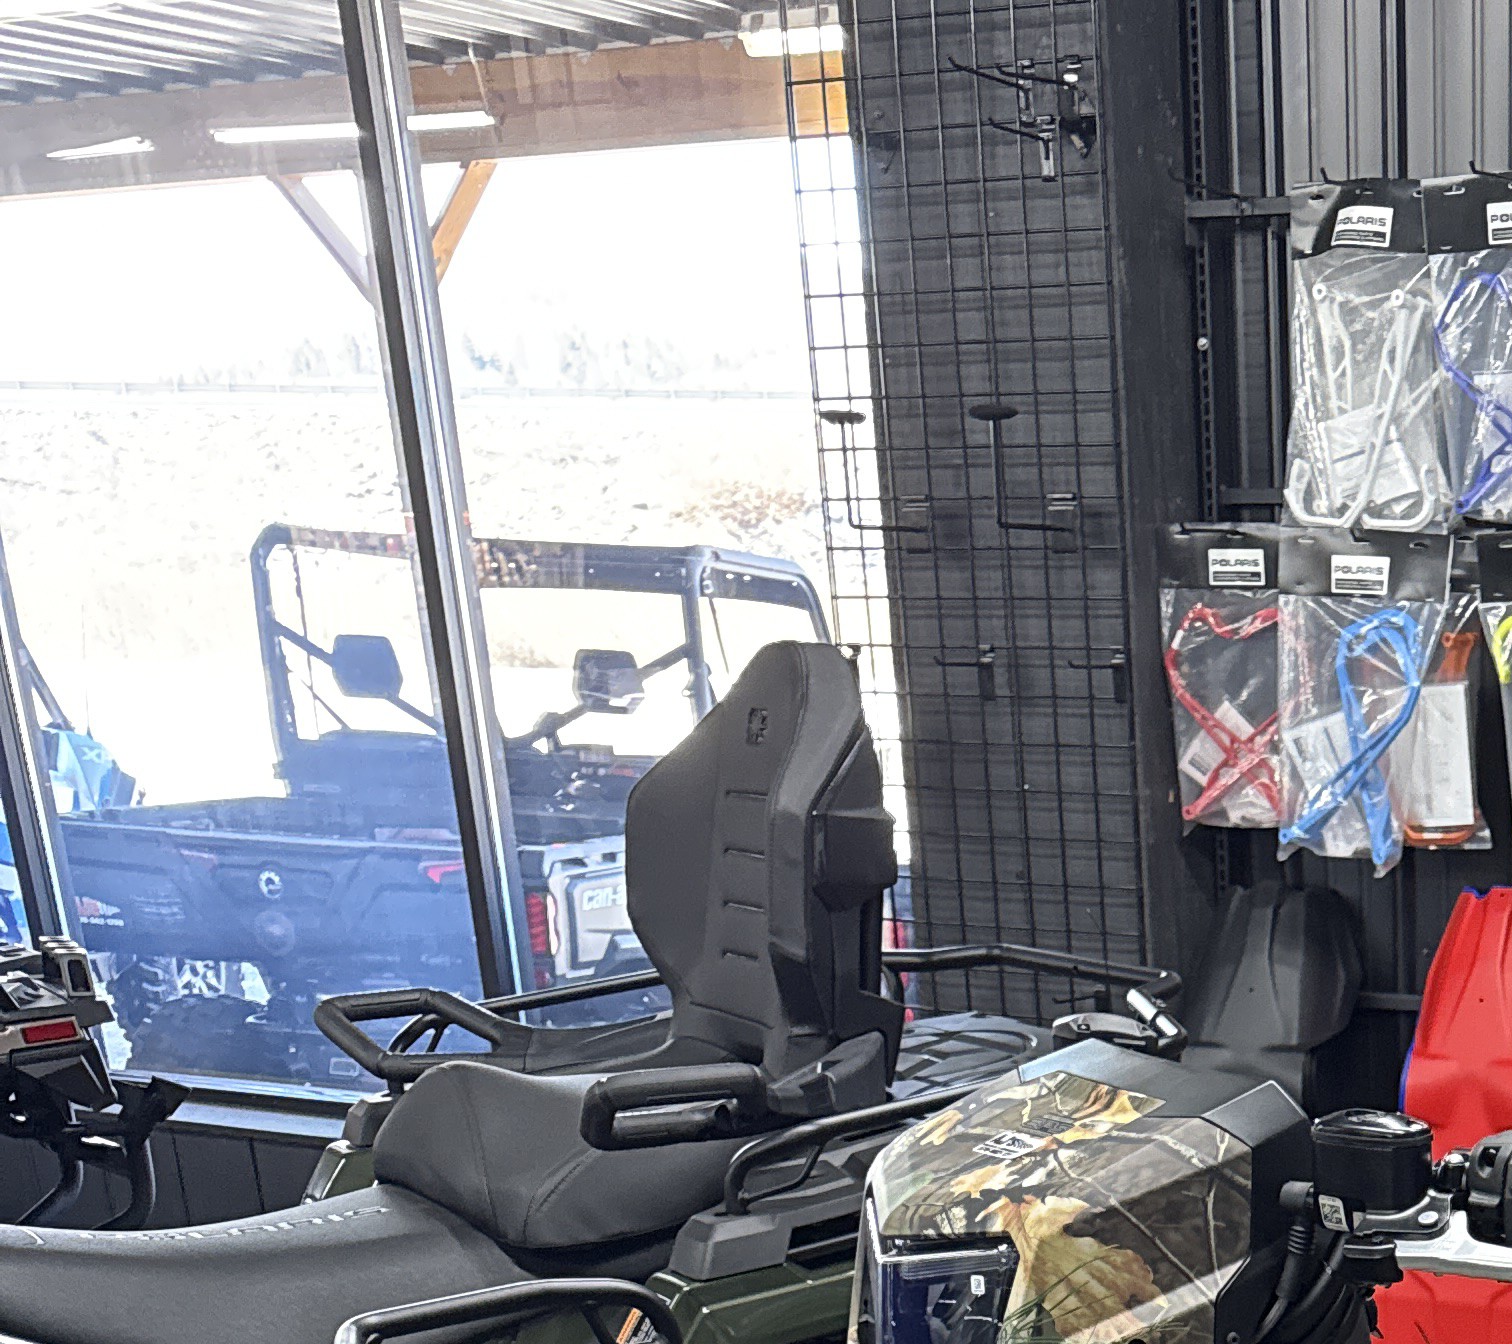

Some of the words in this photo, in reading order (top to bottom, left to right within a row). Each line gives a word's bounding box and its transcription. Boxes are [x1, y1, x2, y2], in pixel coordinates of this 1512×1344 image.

[1337, 216, 1386, 227] POLARIS
[1212, 559, 1260, 568] POLARIS
[1334, 565, 1384, 576] POLARIS
